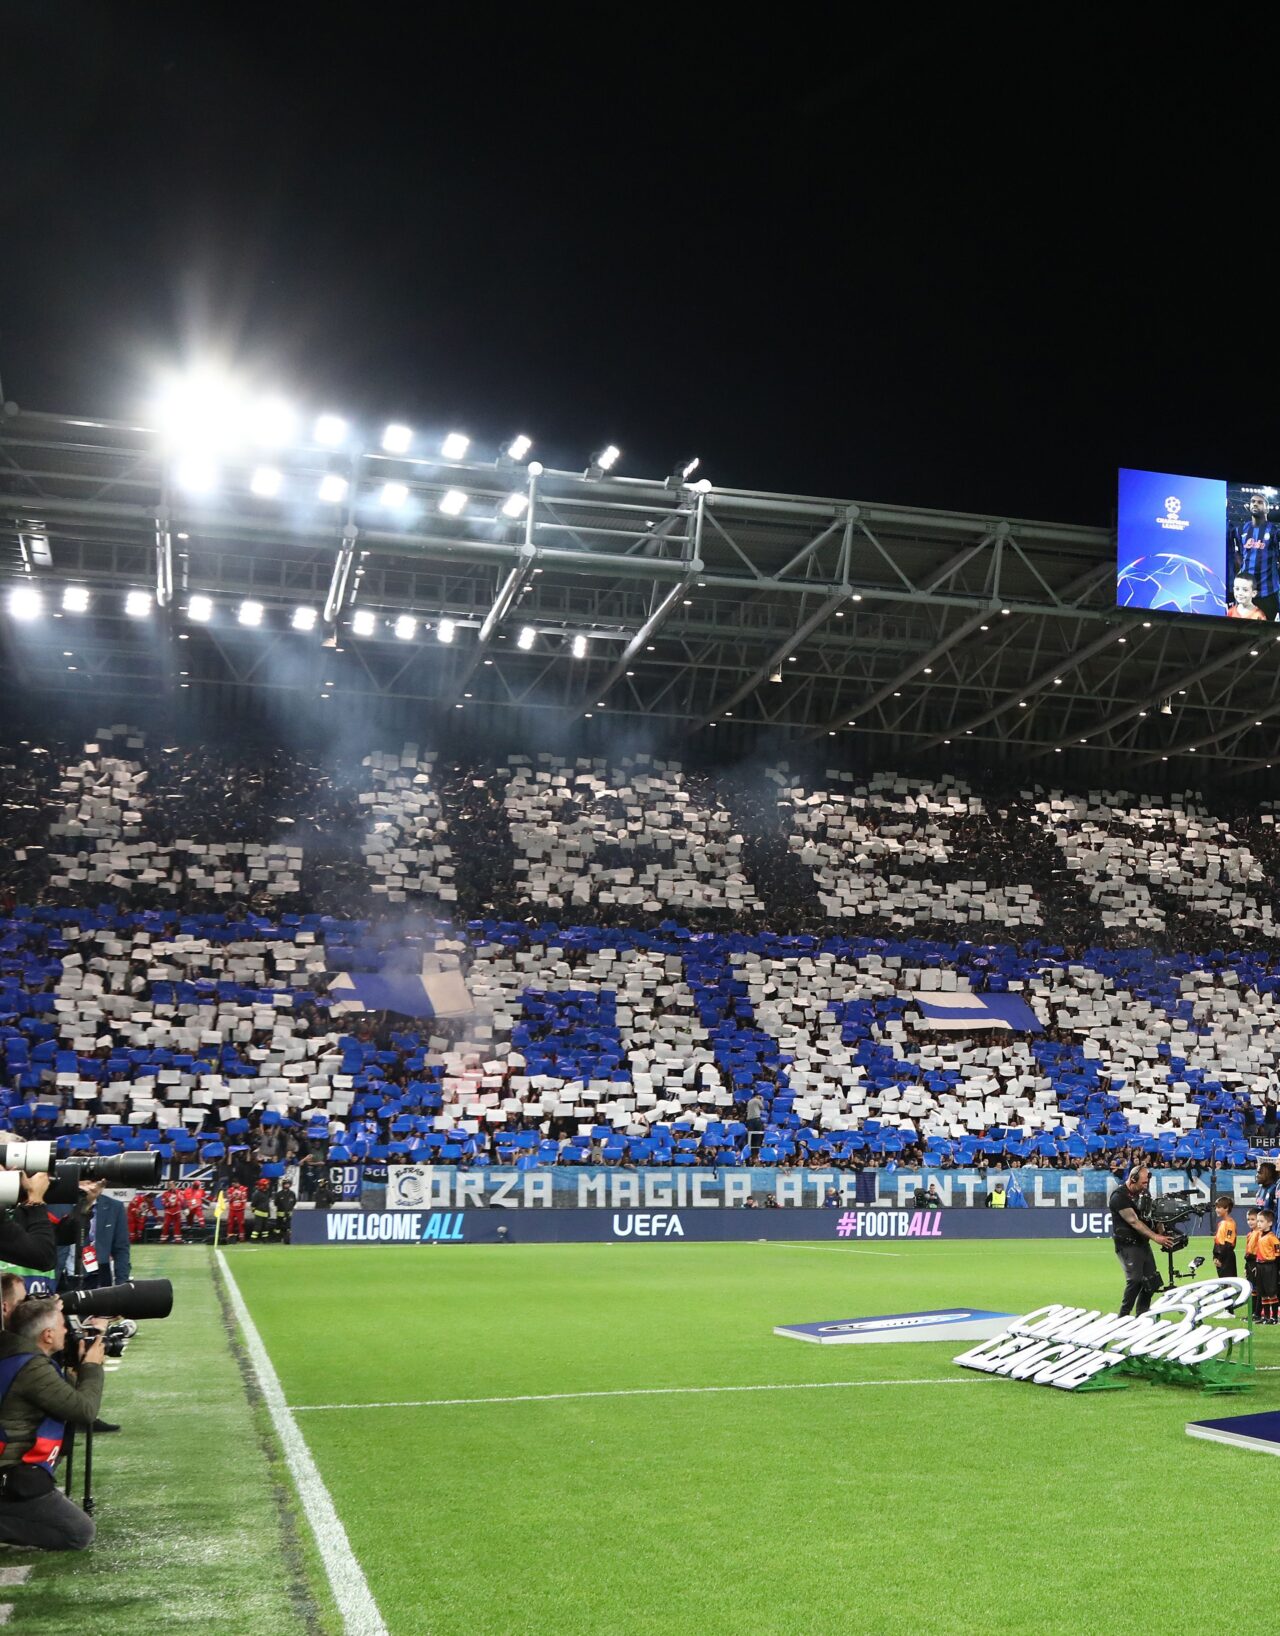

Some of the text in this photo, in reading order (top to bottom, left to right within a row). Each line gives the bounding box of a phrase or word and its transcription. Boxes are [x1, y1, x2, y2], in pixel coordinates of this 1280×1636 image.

[1255, 1137, 1275, 1147] PER
[329, 1166, 359, 1184] GD
[332, 1184, 358, 1194] 907
[431, 1171, 553, 1208] ORZA
[577, 1172, 751, 1208] MAGICA
[1034, 1175, 1085, 1208] LA
[326, 1213, 465, 1240] WELCOME ALL
[612, 1213, 685, 1237] UEFA
[836, 1210, 942, 1238] #FOOTBALL
[1070, 1212, 1113, 1234] UEF
[1006, 1303, 1251, 1365] CHAMPIONS
[951, 1332, 1127, 1390] LEAGUE
